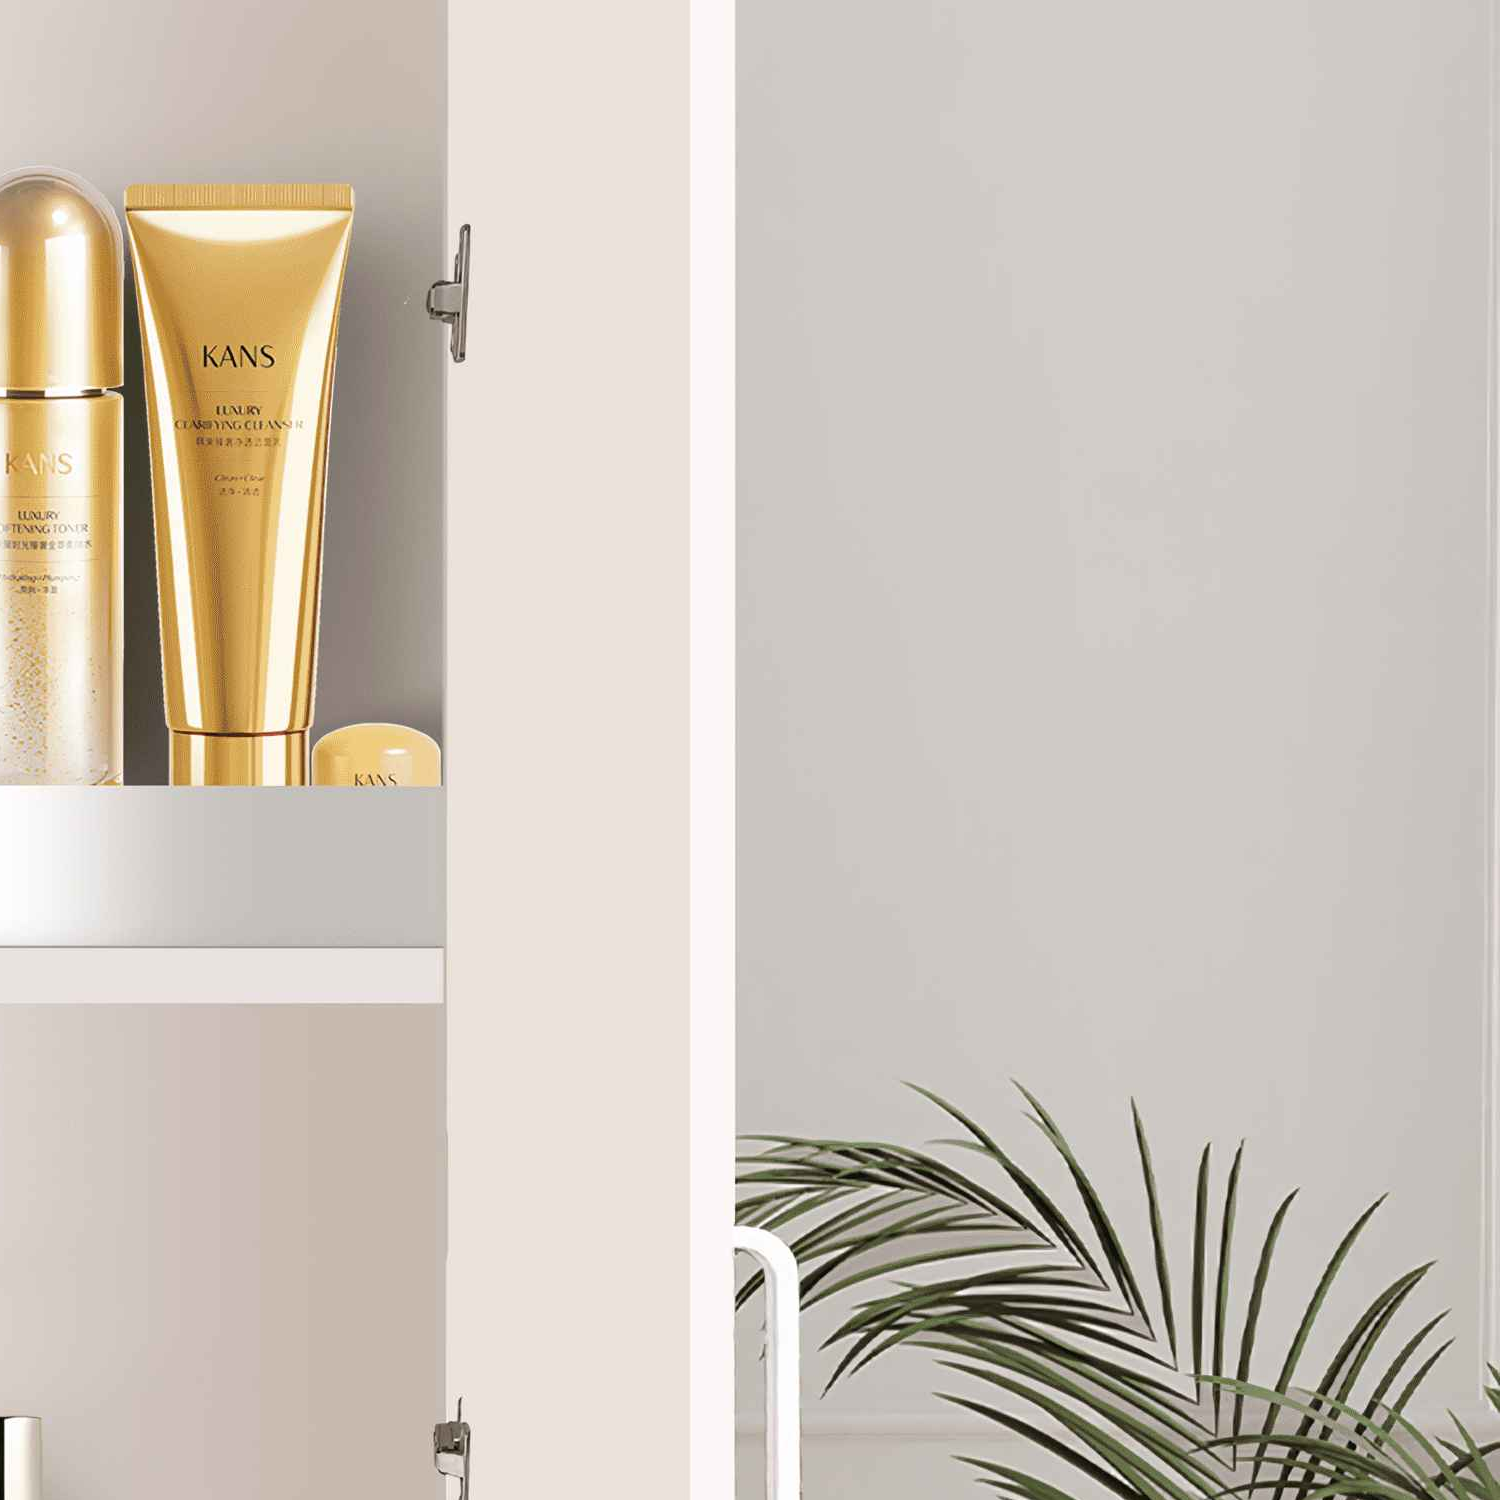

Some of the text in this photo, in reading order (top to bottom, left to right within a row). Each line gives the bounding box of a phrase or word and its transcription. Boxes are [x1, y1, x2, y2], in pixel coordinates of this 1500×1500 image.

[203, 344, 276, 368] KANS
[215, 405, 263, 415] LUXURY
[5, 452, 74, 475] KANS
[17, 510, 60, 521] LUXURY
[354, 773, 398, 787] KANS
